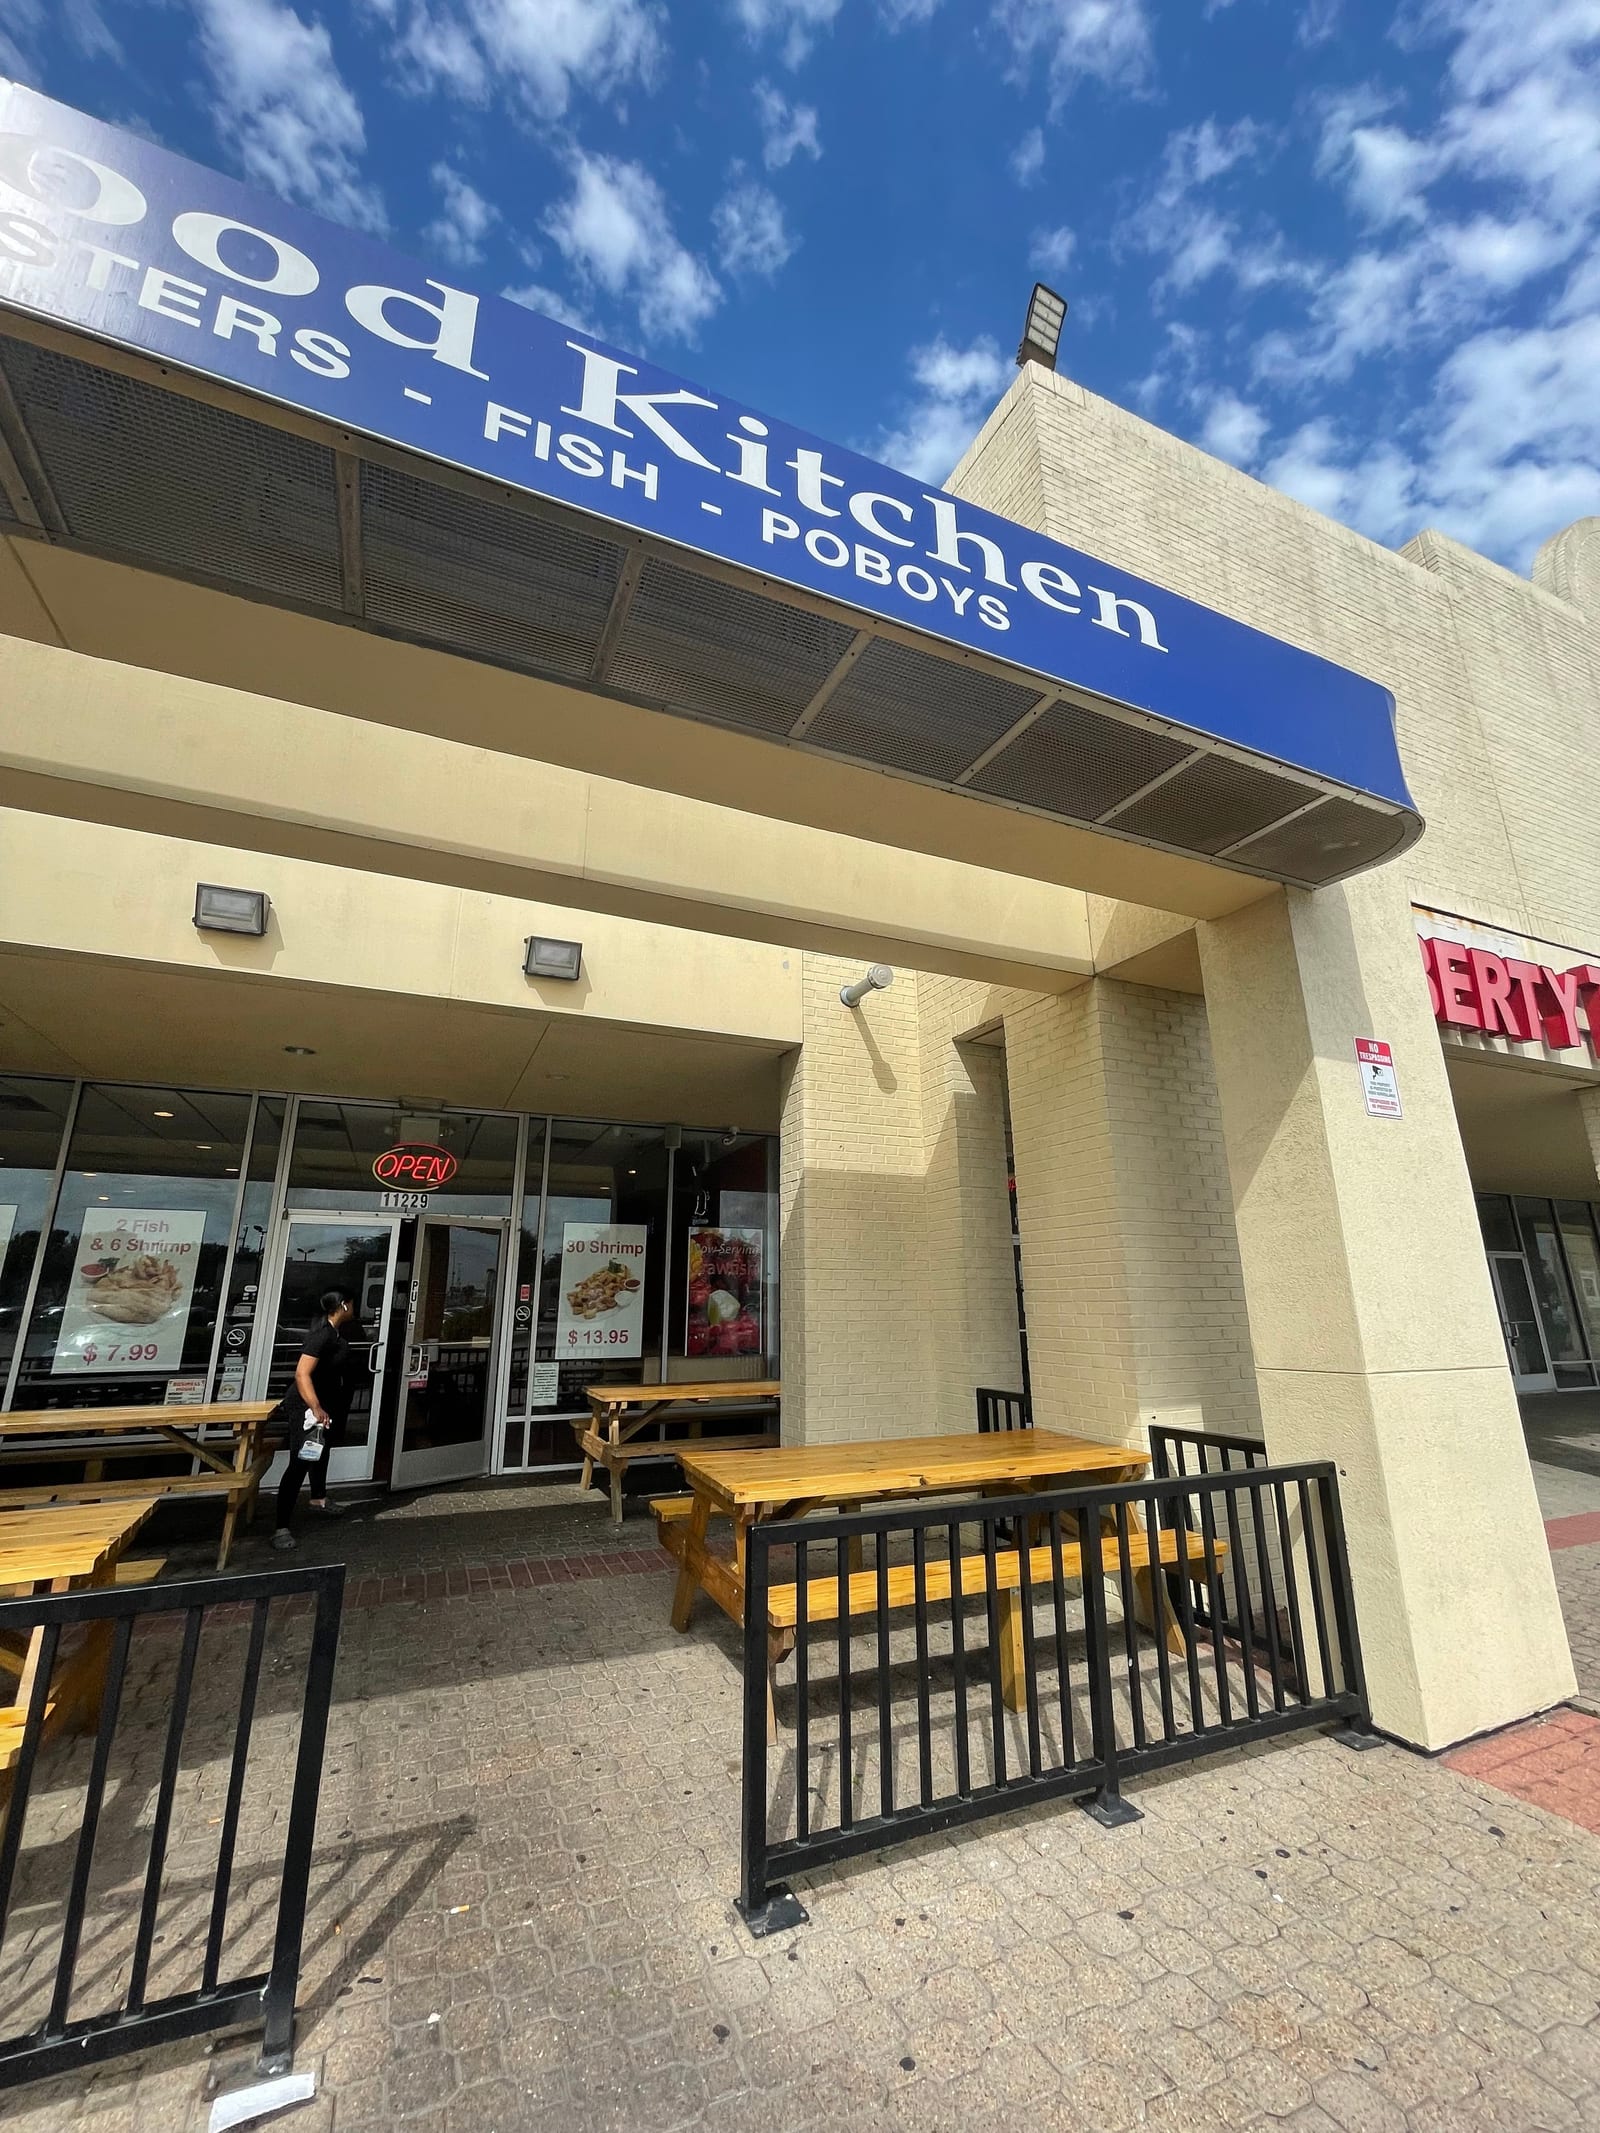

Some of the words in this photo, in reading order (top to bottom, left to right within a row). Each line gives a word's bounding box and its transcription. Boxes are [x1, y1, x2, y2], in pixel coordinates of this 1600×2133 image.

[0, 132, 489, 382] ood
[560, 340, 1169, 654] Kitchen
[0, 211, 351, 379] STERS
[484, 401, 658, 501] FISH
[762, 506, 1011, 632] POBOYS
[1368, 1042, 1379, 1053] NO
[377, 1154, 450, 1180] OPEN
[383, 1192, 428, 1208] 11229
[116, 1219, 127, 1232] 2
[132, 1219, 170, 1233] Fish
[90, 1238, 104, 1251] &
[110, 1238, 121, 1251] 6
[126, 1238, 192, 1255] Shrimp
[566, 1240, 585, 1253] 30
[589, 1240, 644, 1257] Shrimp
[408, 1280, 419, 1325] PULL
[568, 1329, 578, 1347] $
[583, 1329, 629, 1344] 13.95
[82, 1343, 97, 1365] $
[107, 1343, 159, 1361] 7.99
